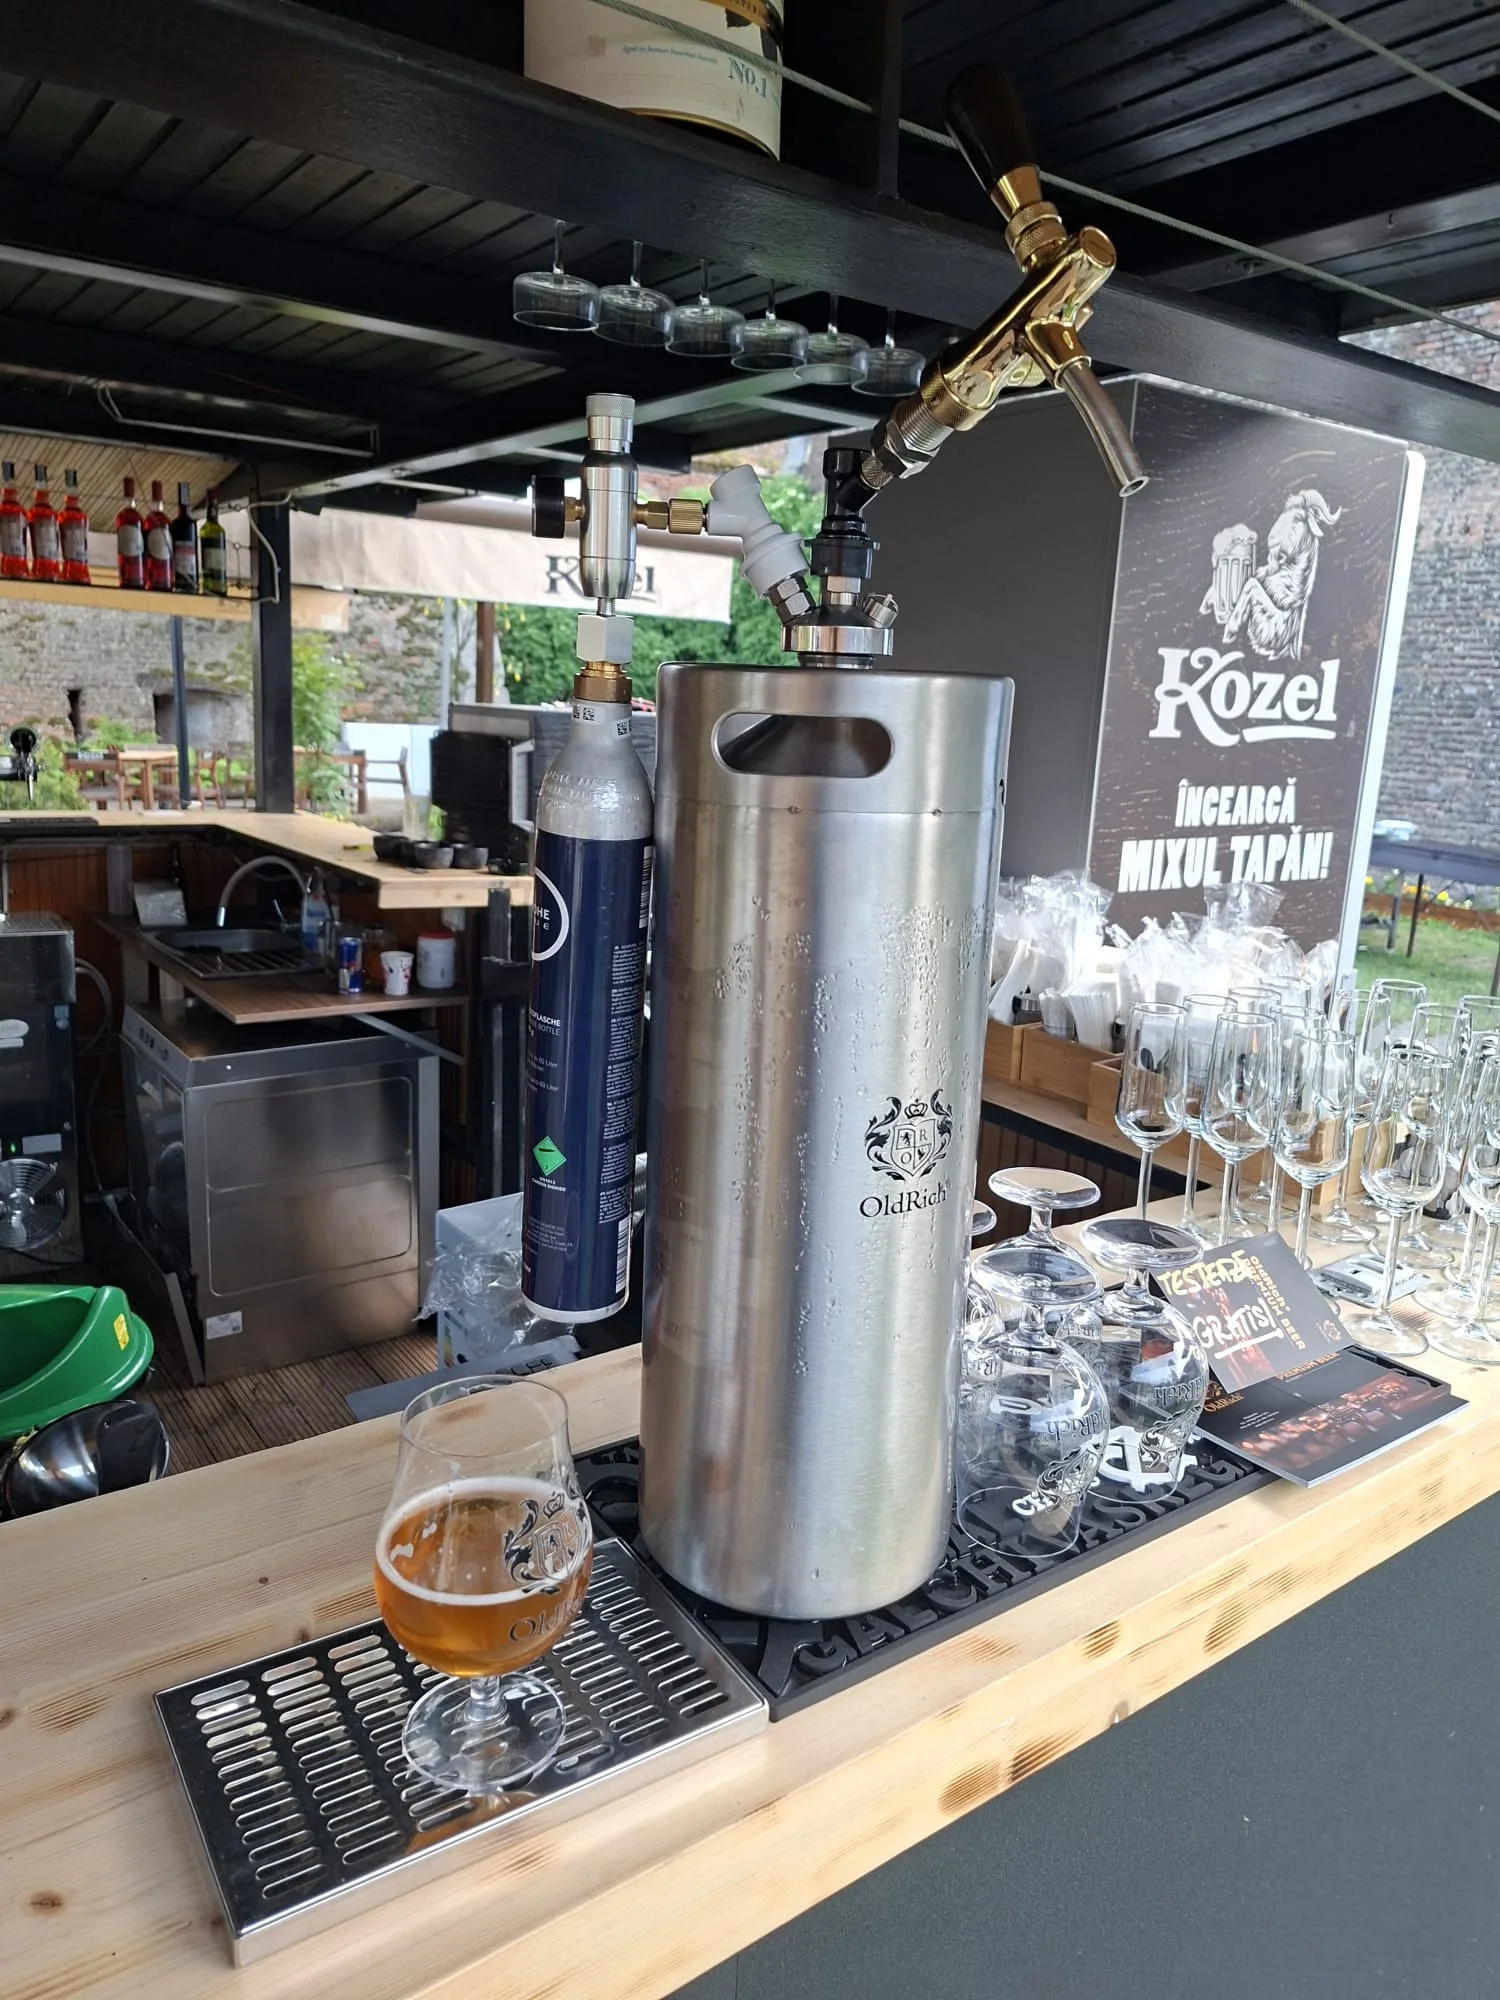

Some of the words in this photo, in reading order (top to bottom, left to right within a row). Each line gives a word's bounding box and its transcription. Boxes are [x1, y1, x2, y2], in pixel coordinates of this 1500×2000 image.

[545, 554, 655, 598] Kel
[1149, 647, 1341, 747] Kozel
[1175, 777, 1297, 828] ÎNCEARCĂ
[1117, 836, 1221, 893] MIXUL
[1230, 825, 1334, 887] TAPĂN!
